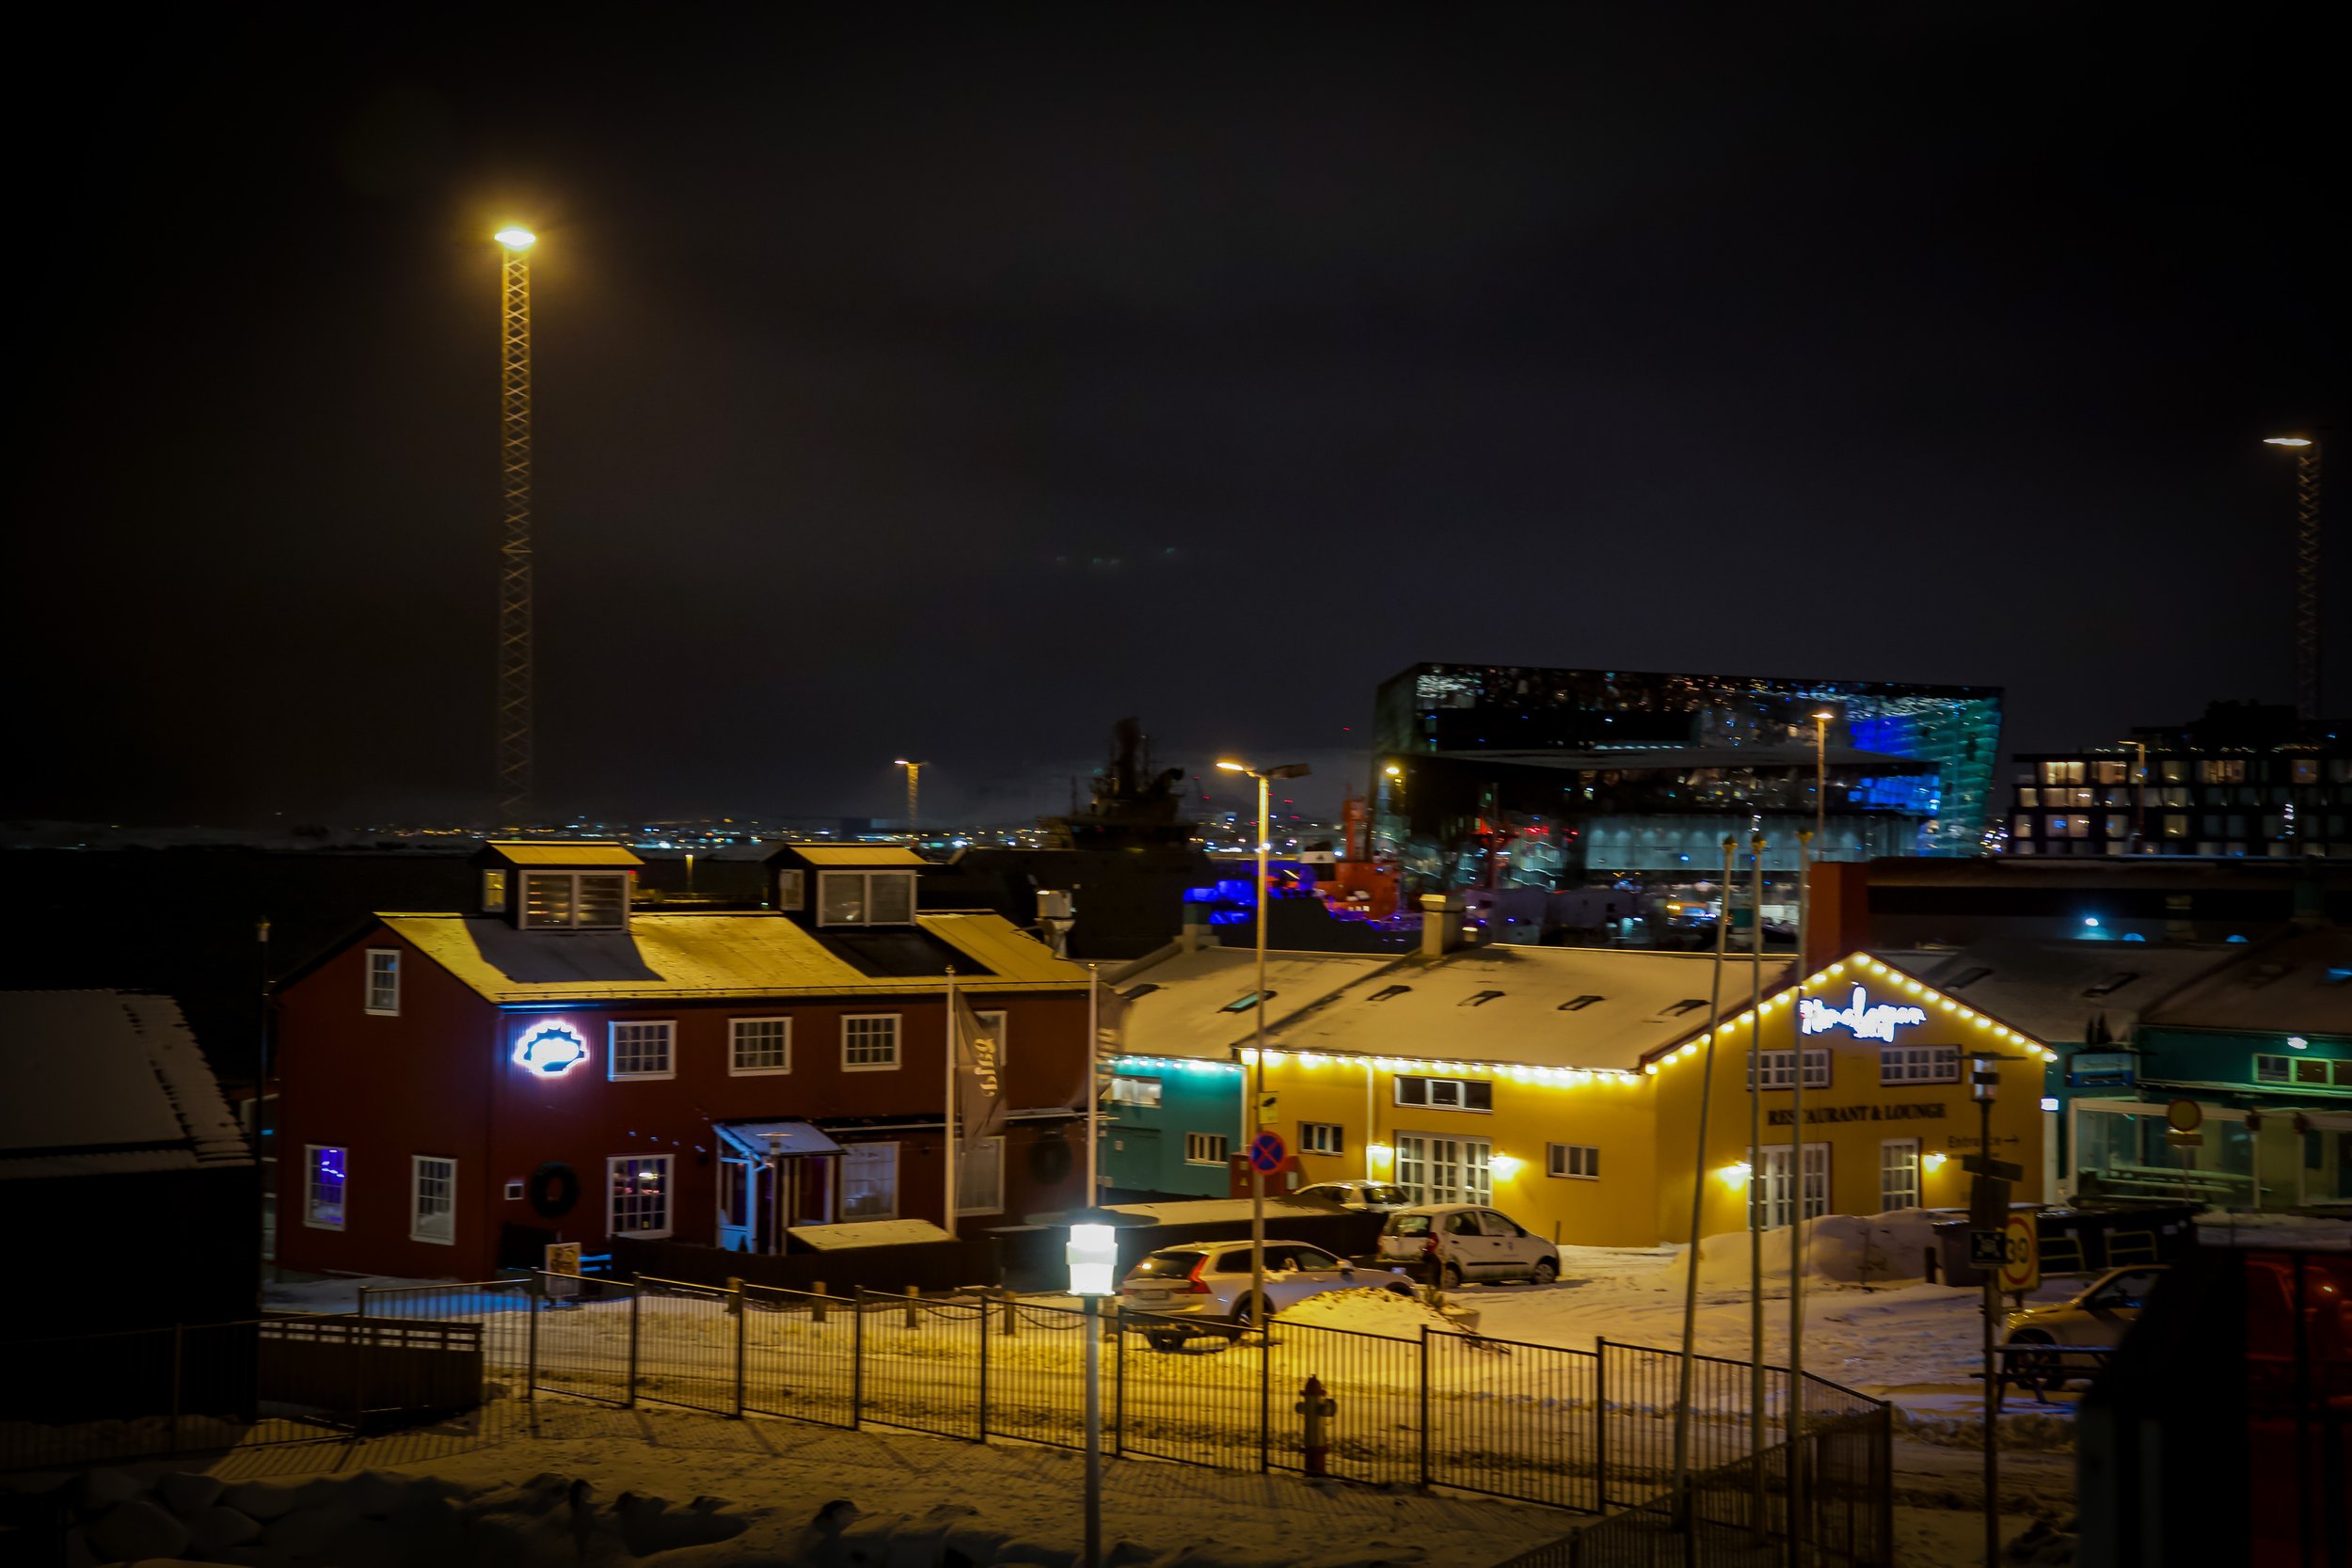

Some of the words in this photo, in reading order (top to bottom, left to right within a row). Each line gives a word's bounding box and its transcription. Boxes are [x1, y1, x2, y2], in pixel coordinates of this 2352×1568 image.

[1768, 1104, 1868, 1126] RESAURANT
[1869, 1105, 1883, 1121] &
[1884, 1102, 1946, 1120] LOUNGE
[1947, 1134, 2001, 1148] Entrace
